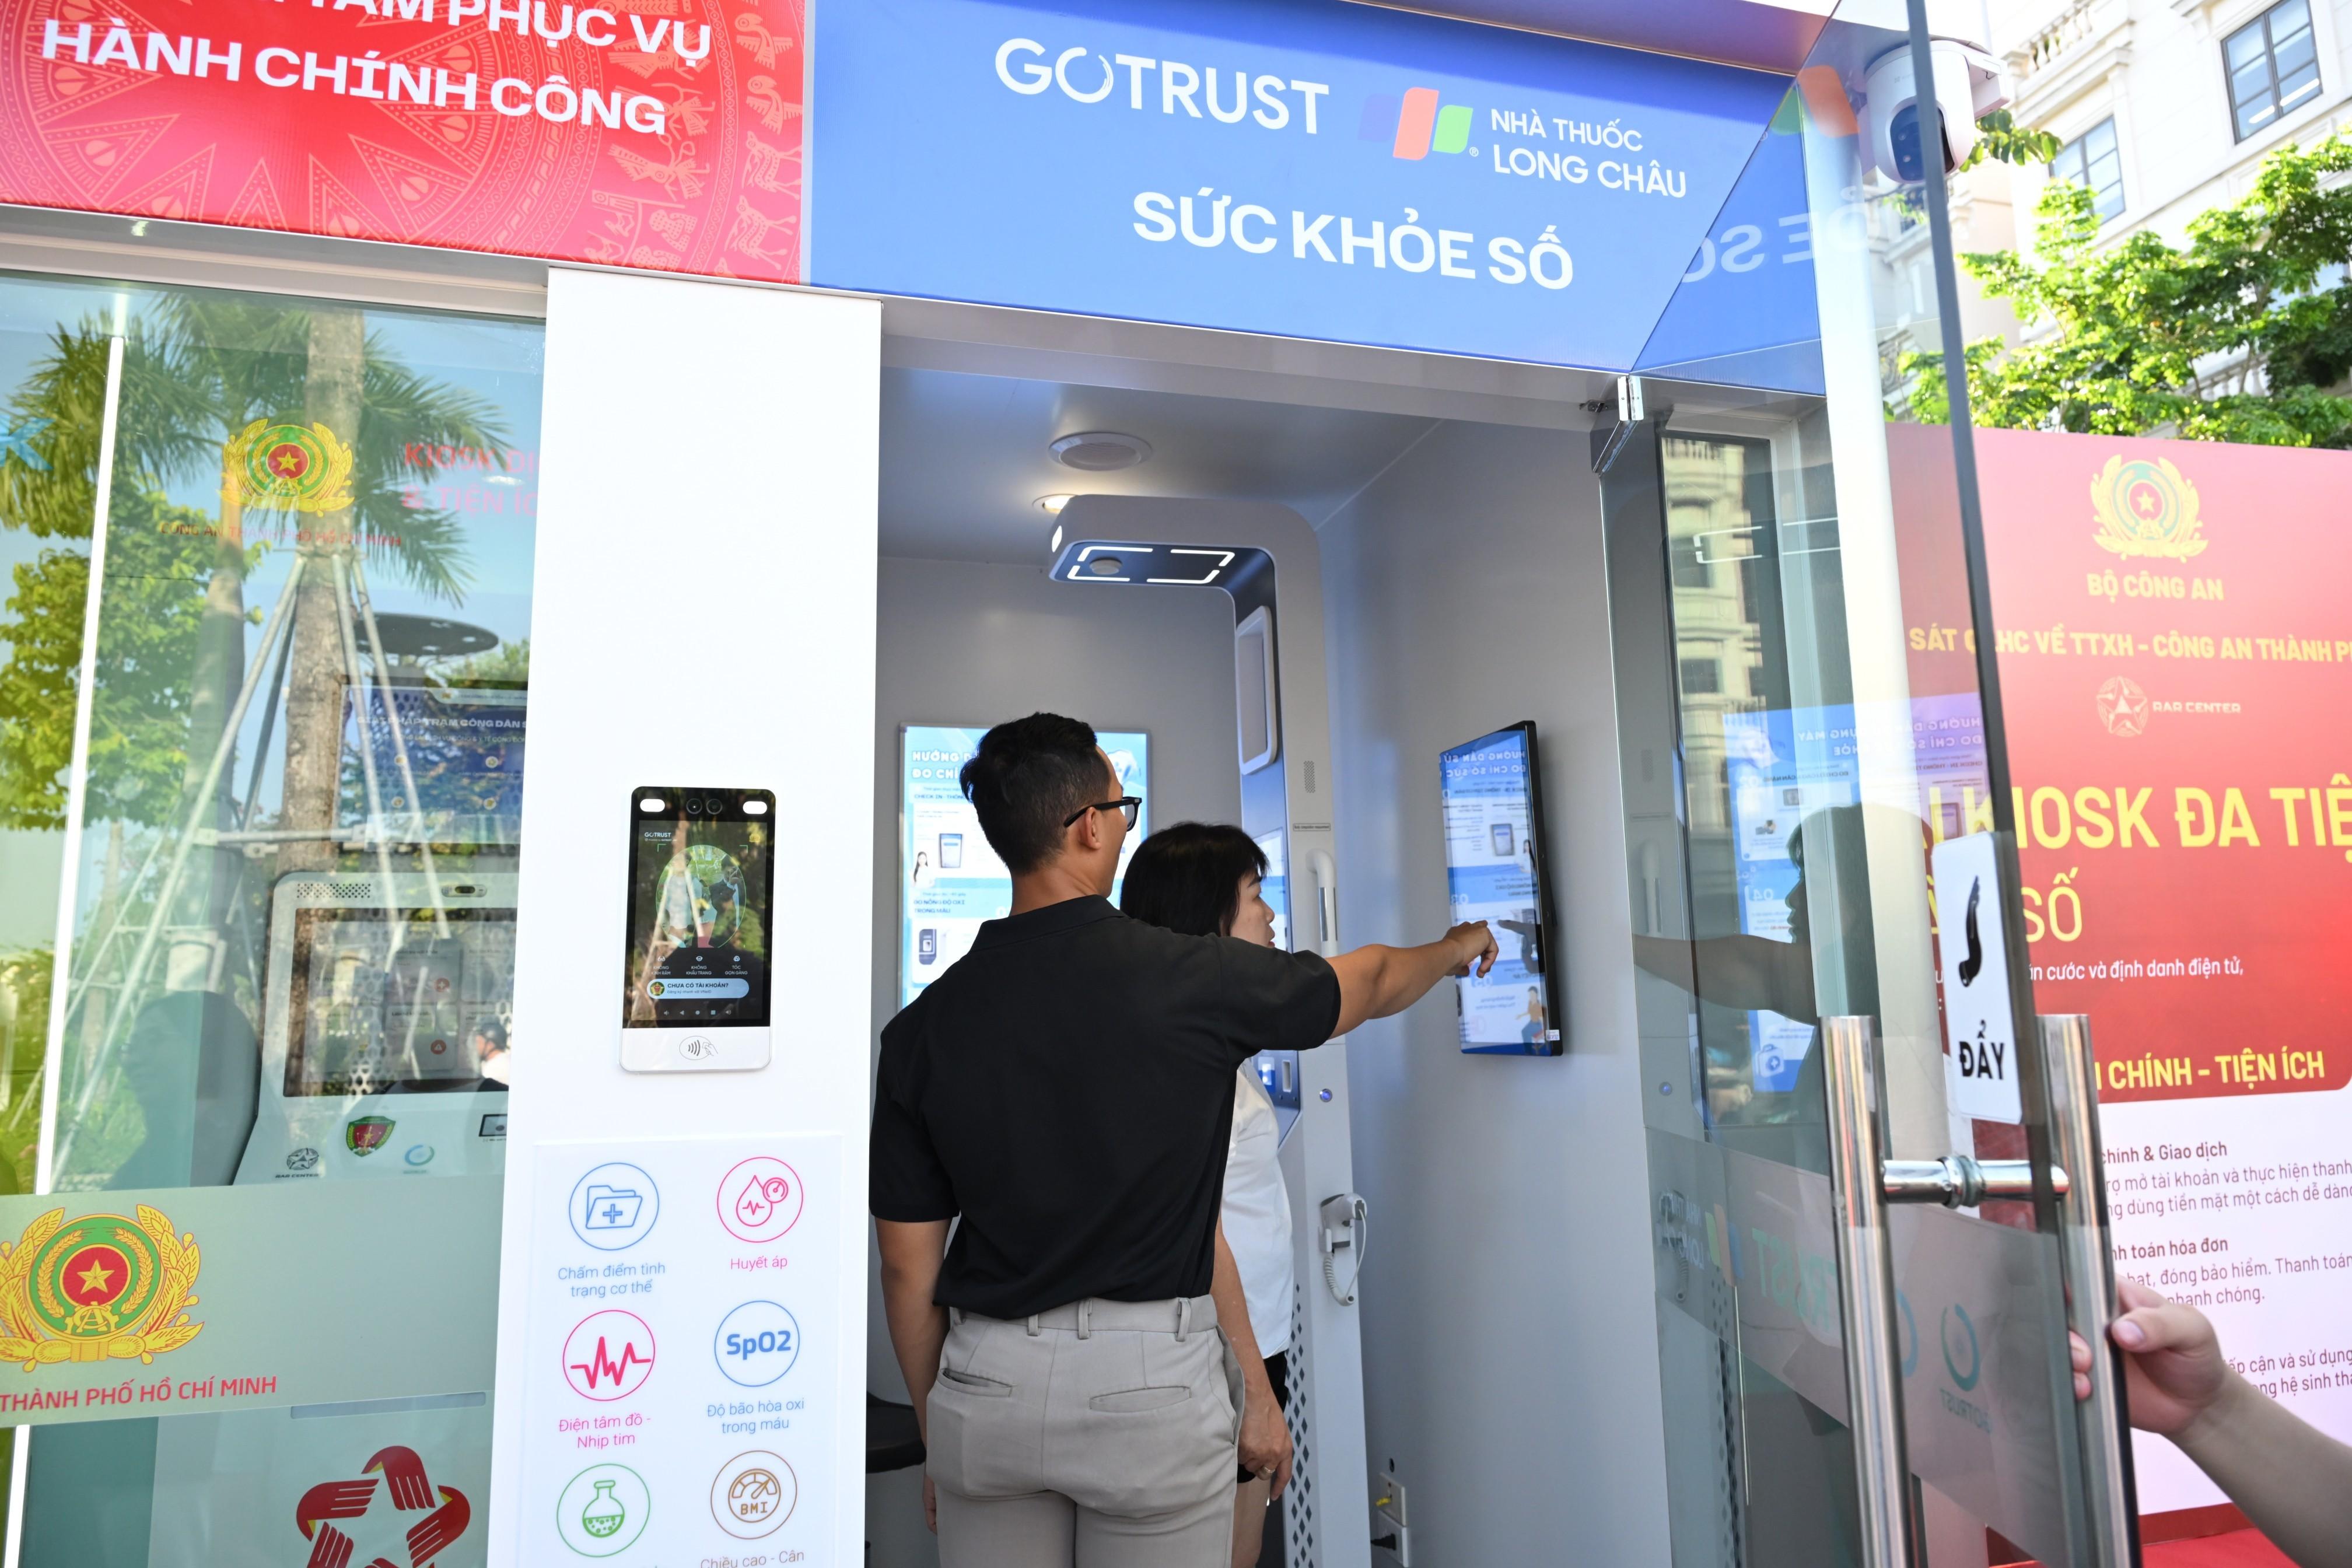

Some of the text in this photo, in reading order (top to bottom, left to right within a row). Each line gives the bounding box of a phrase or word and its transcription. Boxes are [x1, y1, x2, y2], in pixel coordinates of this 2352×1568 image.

[449, 0, 616, 47] PHỤC
[629, 15, 710, 67] VỤ
[42, 17, 666, 135] HÀNH CHÍNH CÔNG
[995, 38, 1329, 134] GOTRUST
[1491, 108, 1643, 152] NHÀ THUỐC
[1493, 144, 1686, 198] LONG CHÂU
[1133, 187, 1573, 290] SỨC KHỎE SỐ
[405, 442, 539, 480] KIOSK DỊ
[401, 482, 538, 519] & TIỆN ÍC
[2087, 569, 2224, 604] BỘ CÔNG AN
[1909, 622, 1958, 652] SÁT
[2034, 622, 2067, 654] VỀ
[2070, 632, 2134, 657] TTXH
[2153, 630, 2216, 659] CÔNG
[2220, 637, 2253, 660] AN
[2256, 634, 2333, 662] THÀNH
[2186, 702, 2241, 713] CENTER
[460, 718, 494, 727] CÔNG
[496, 718, 520, 729] DÂN
[912, 749, 960, 762] HƯỚNG
[1962, 773, 2352, 863] KIOSK ĐA TIỆ
[2020, 867, 2082, 943] SỐ
[2046, 955, 2244, 982] cước và định danh điện tử,
[1959, 1020, 2004, 1080] ĐẨY
[2108, 1052, 2193, 1090] CHÍNH
[2214, 1047, 2277, 1090] TIỆN
[2281, 1046, 2325, 1080] ÍCH
[2102, 1141, 2228, 1164] chính & Giao dịch
[2106, 1159, 2352, 1196] rợ mở tài khoản và thực hiện thanh
[2108, 1203, 2123, 1220] ng
[2127, 1199, 2164, 1217] dùng
[2168, 1192, 2197, 1212] tiền
[2201, 1192, 2229, 1212] mặt
[2233, 1190, 2261, 1209] một
[2265, 1186, 2299, 1204] cách
[2303, 1181, 2319, 1201] dễ
[731, 1255, 788, 1272] Huyết áp
[2112, 1237, 2228, 1261] nh toán hóa đơn
[558, 1265, 598, 1280] Chấm
[603, 1263, 636, 1278] điểm
[2160, 1268, 2197, 1286] đóng
[2201, 1263, 2228, 1281] bảo
[2231, 1257, 2272, 1278] hiểm.
[2275, 1255, 2319, 1273] Thanh
[570, 1279, 653, 1298] trạng cơ thể
[2216, 1286, 2265, 1304] chóng.
[727, 1330, 791, 1360] SpO2
[2249, 1348, 2352, 1376] cận và sử dụng
[0, 1376, 277, 1413] THÀNH PHỐ HỒ CHÍ MINH
[2281, 1376, 2298, 1396] hệ
[2302, 1372, 2331, 1391] sinh
[559, 1412, 643, 1433] Điện tâm đồ
[707, 1397, 804, 1419] Độ bão hòa oxi
[722, 1416, 789, 1434] trong máu
[578, 1433, 635, 1450] Nhịp tim
[740, 1502, 768, 1516] BMI
[701, 1549, 804, 1568] Chiều cao Cân
